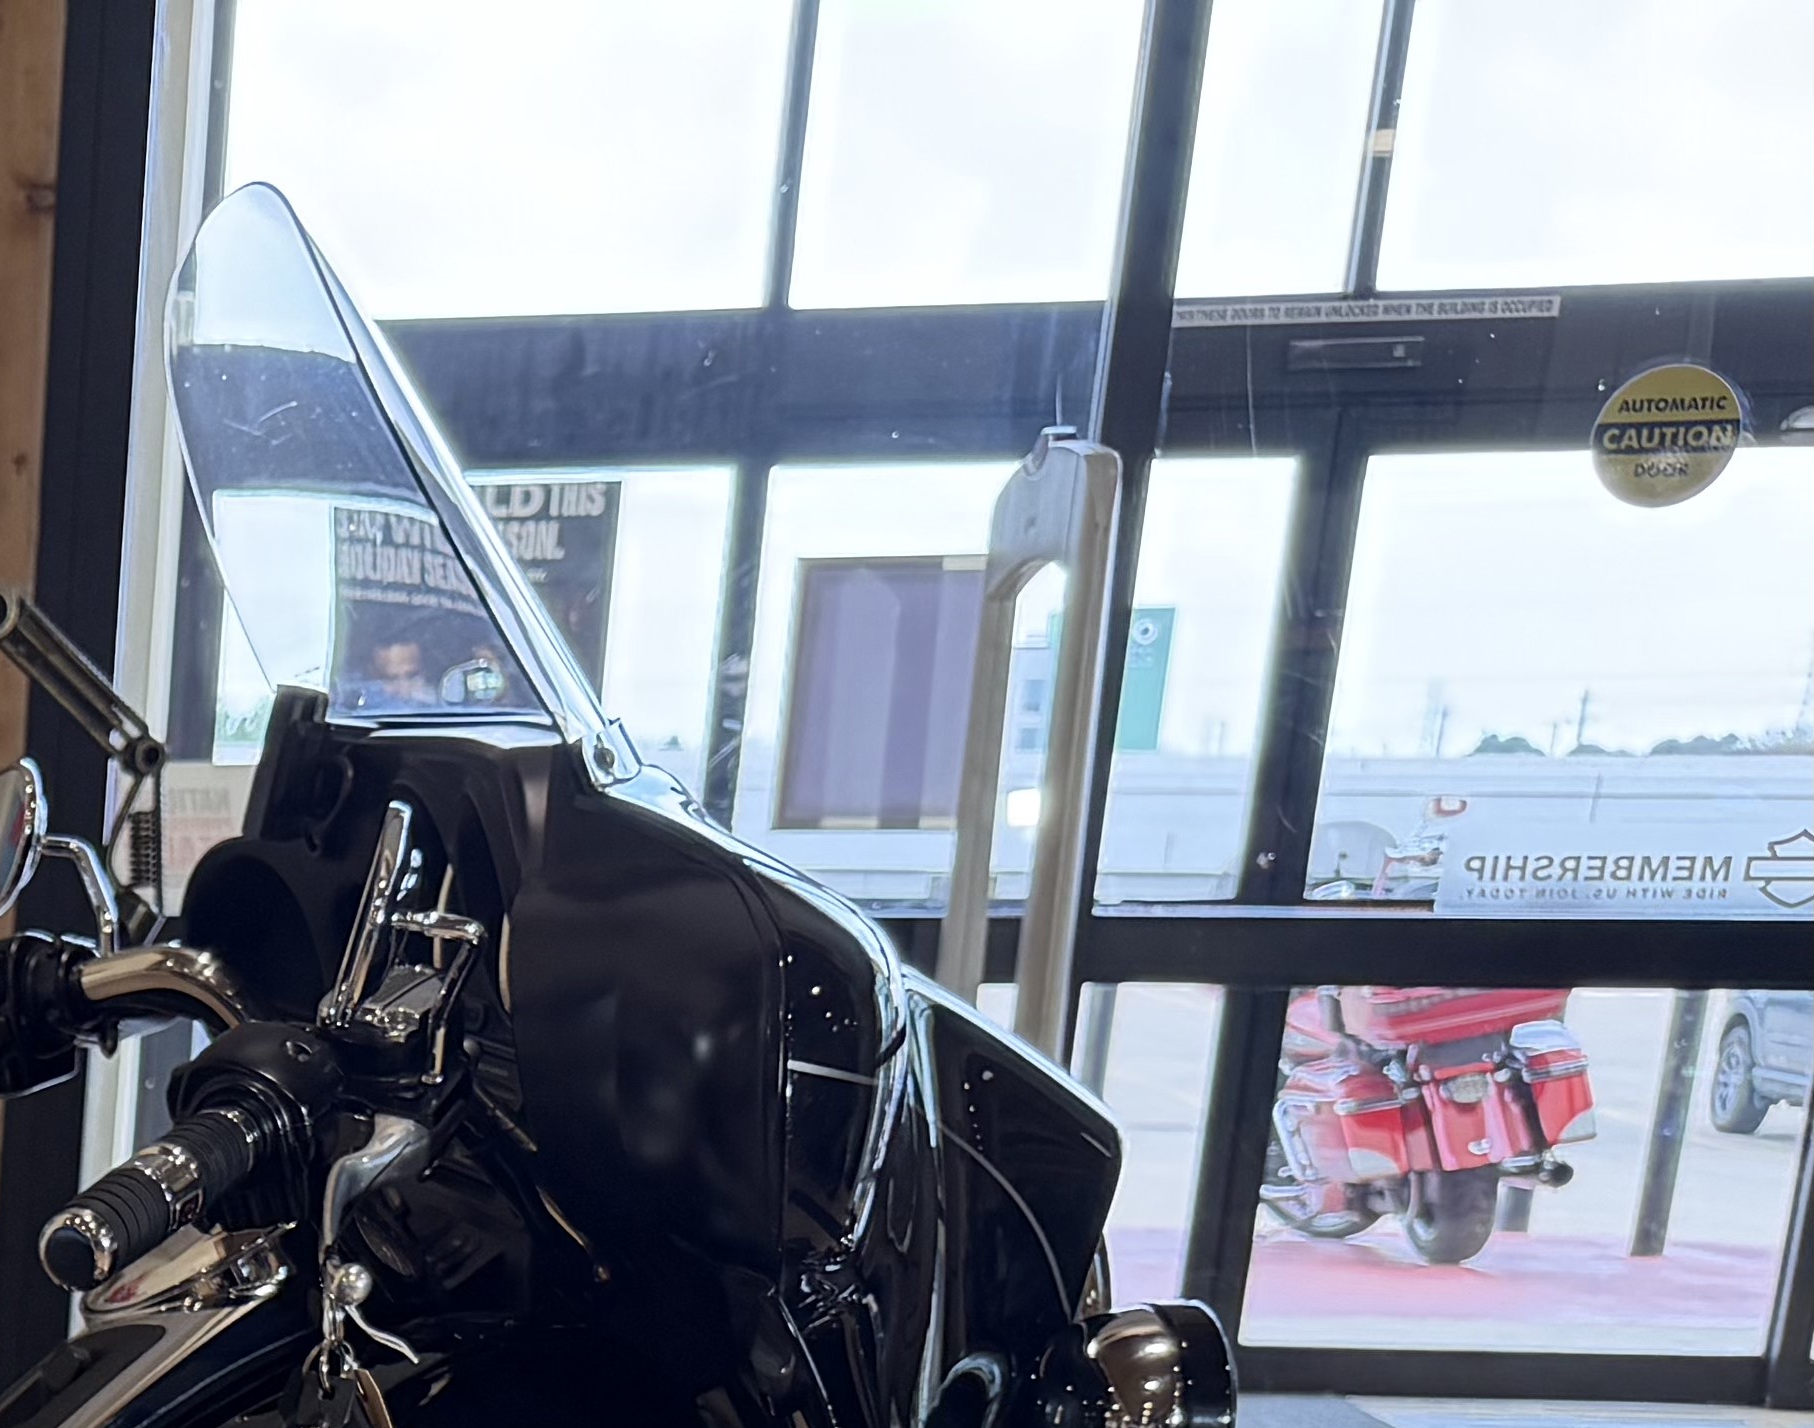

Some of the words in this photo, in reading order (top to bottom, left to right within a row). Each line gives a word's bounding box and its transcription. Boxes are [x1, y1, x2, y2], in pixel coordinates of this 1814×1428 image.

[1618, 396, 1727, 414] AUTOMATIC
[1602, 424, 1734, 450] CAUTION
[1633, 462, 1689, 478] DOOR
[549, 483, 607, 518] THIS
